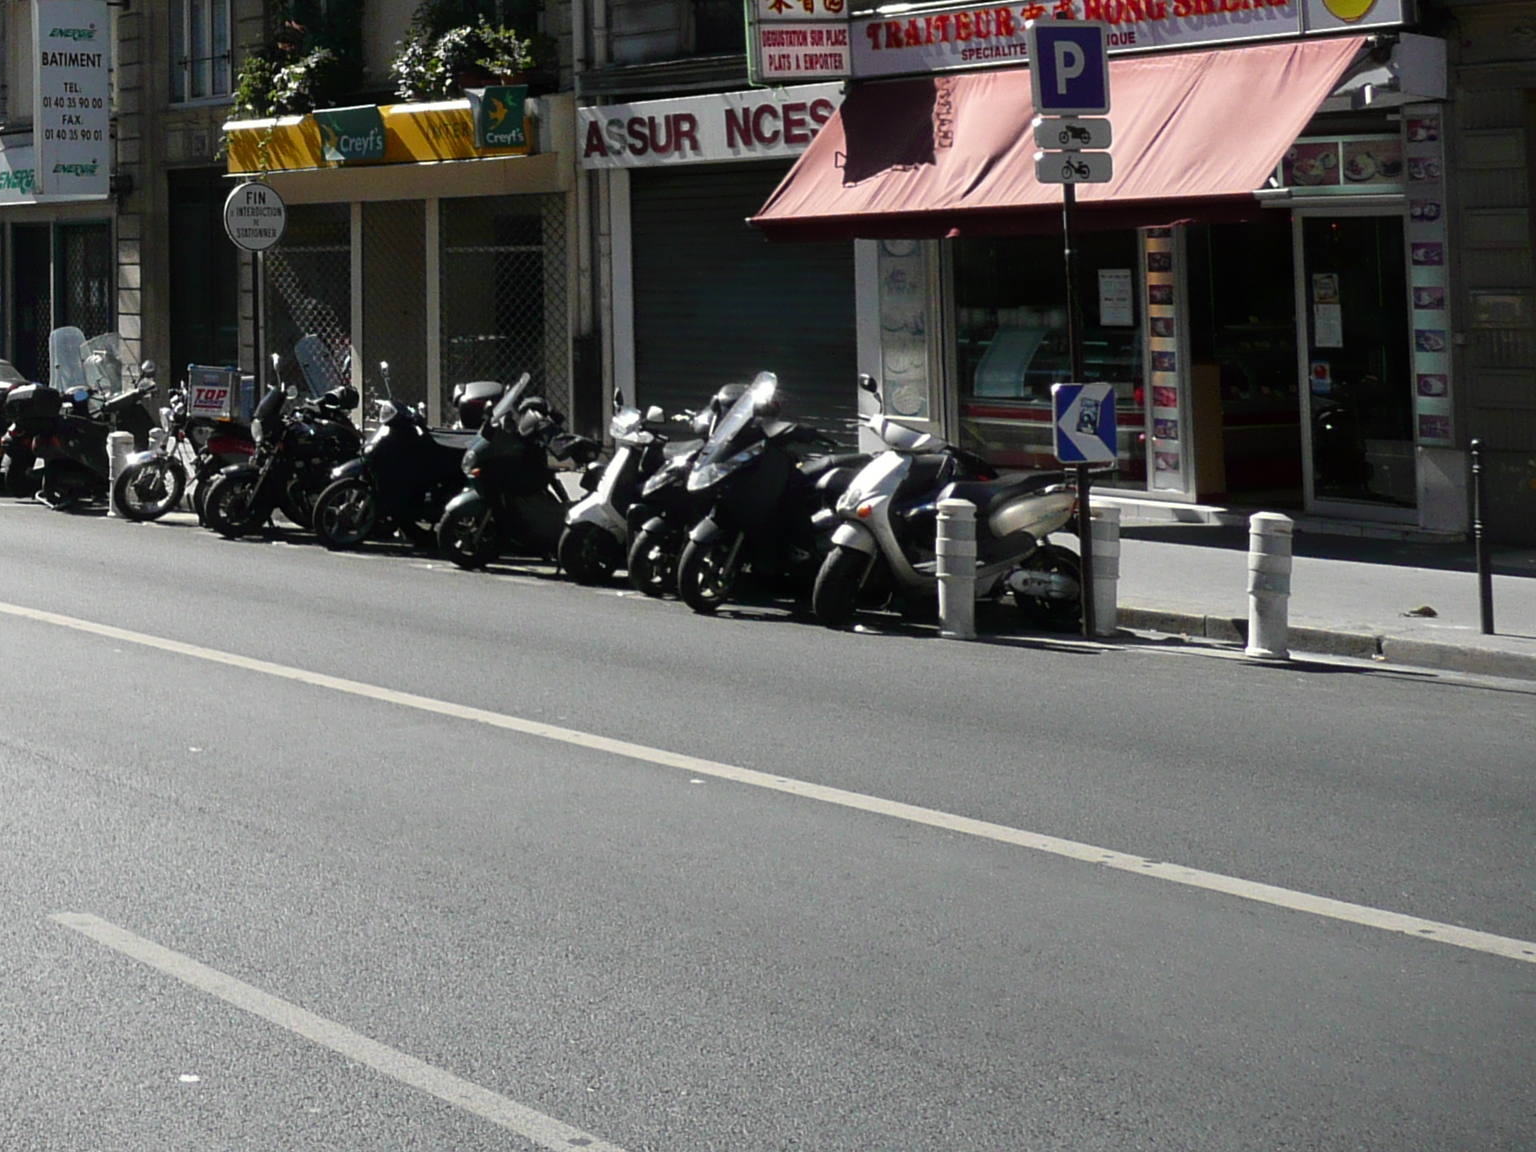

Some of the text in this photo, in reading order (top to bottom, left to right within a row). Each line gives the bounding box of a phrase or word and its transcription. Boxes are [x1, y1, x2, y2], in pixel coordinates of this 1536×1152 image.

[866, 6, 1015, 50] TRAITEUR
[762, 29, 848, 47] DEGUSTATION SUR PLACE
[41, 51, 103, 68] BATIMENT
[960, 42, 1028, 61] SPECIALITE
[769, 53, 844, 71] PLATS A EMPORTER
[1054, 40, 1086, 95] P
[43, 97, 103, 109] 01 40 35 90 00
[45, 130, 103, 141] 01 40 35 90 01
[339, 128, 383, 157] Creyf's
[486, 128, 525, 145] Creyf's
[246, 191, 266, 205] FIN
[196, 388, 227, 400] TOP
